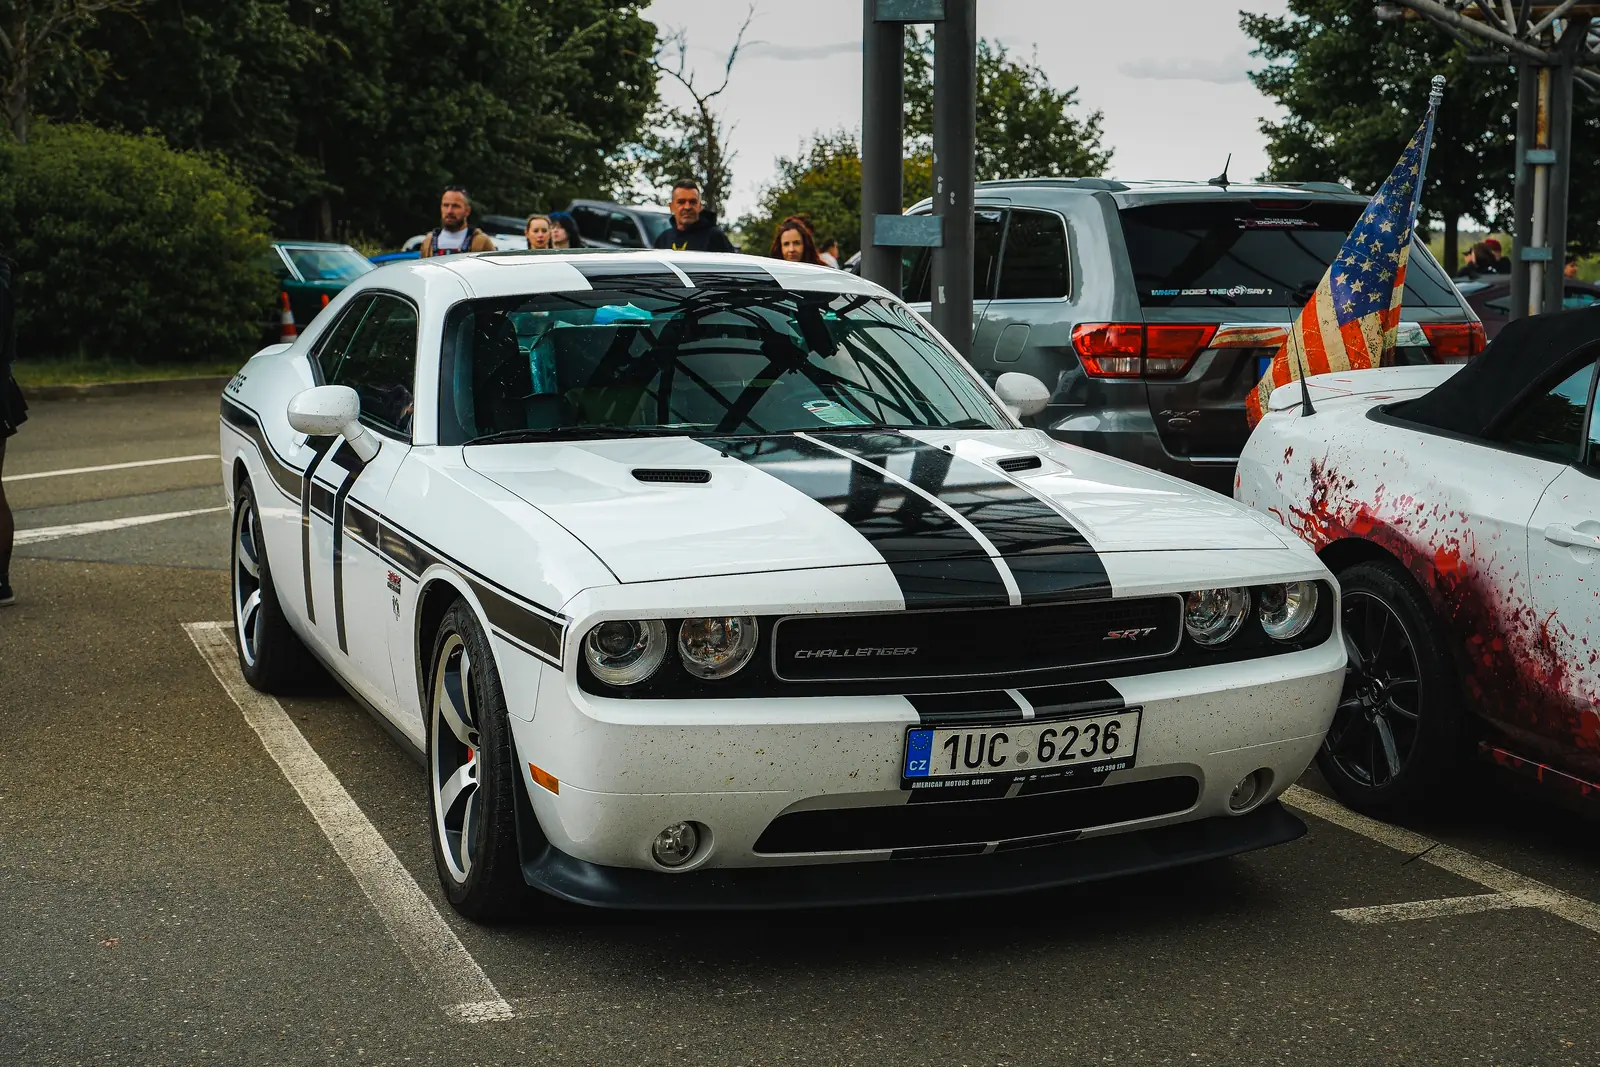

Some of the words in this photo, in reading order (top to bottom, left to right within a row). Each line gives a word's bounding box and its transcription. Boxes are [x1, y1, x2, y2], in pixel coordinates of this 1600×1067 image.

[1102, 626, 1157, 640] SRT
[794, 646, 918, 659] CHALLENGER
[943, 732, 1009, 770] 1UC
[1037, 719, 1122, 763] 6236
[909, 760, 927, 771] CZ
[911, 781, 944, 789] AMERICAN
[944, 779, 970, 787] MOTORS
[971, 778, 992, 786] GROUP
